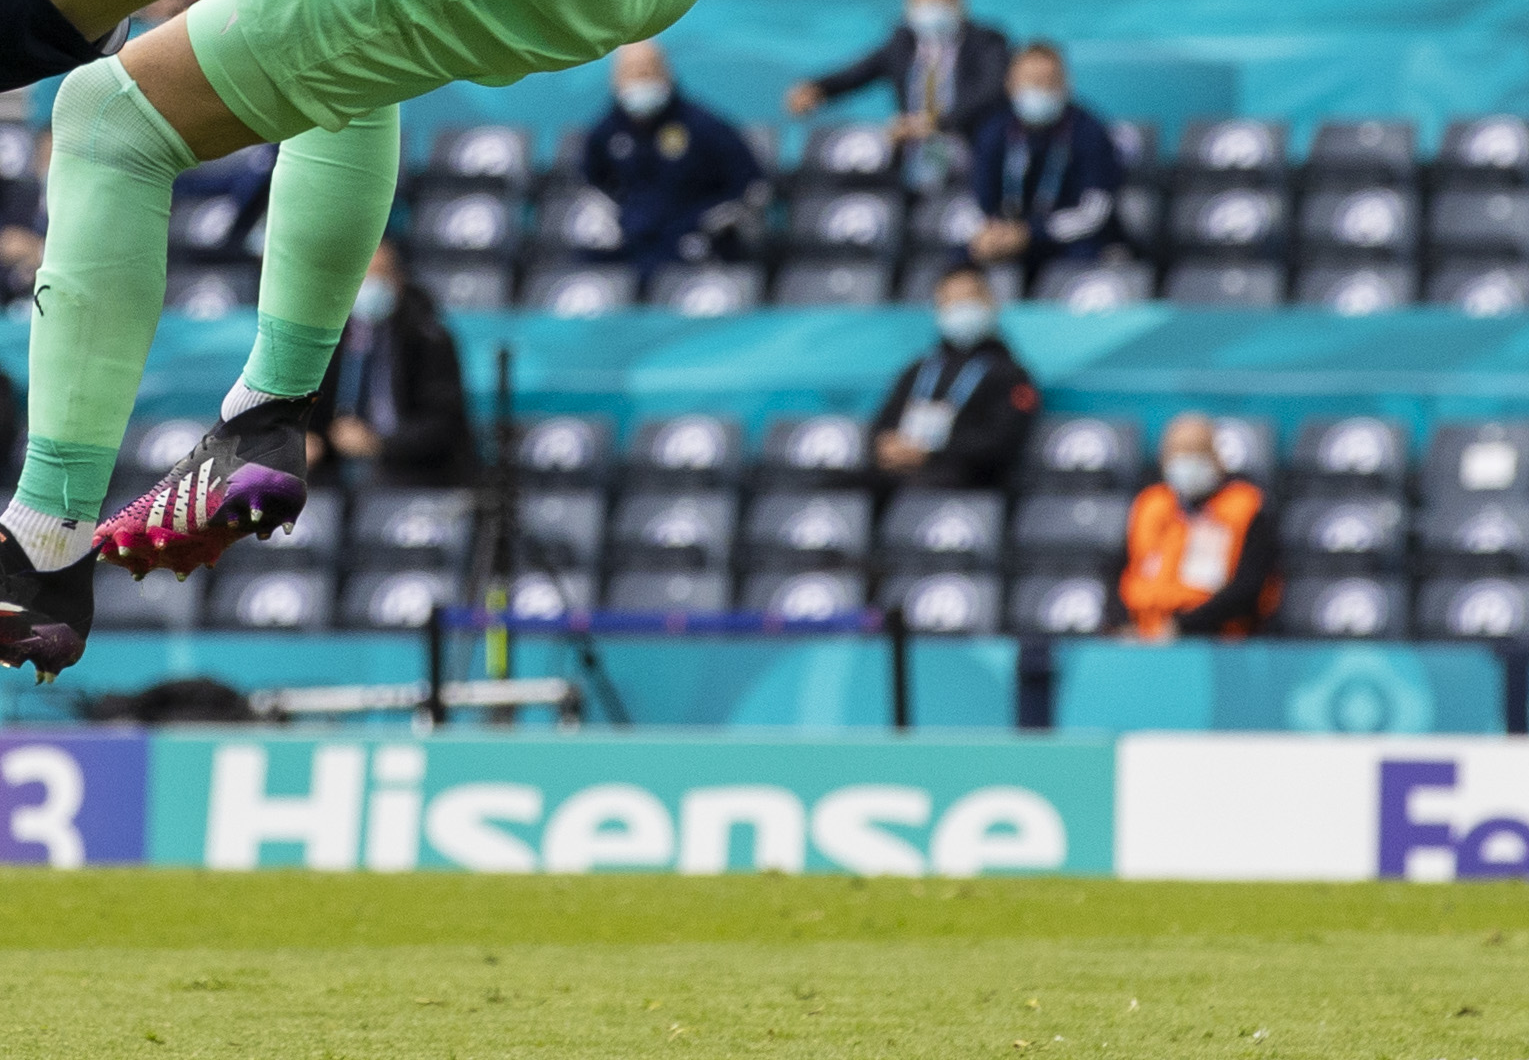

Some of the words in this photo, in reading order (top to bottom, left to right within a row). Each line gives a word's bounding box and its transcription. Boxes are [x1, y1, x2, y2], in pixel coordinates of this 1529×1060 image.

[0, 744, 86, 869] 3
[204, 742, 1068, 876] Hisense
[1377, 759, 1529, 880] Fe
